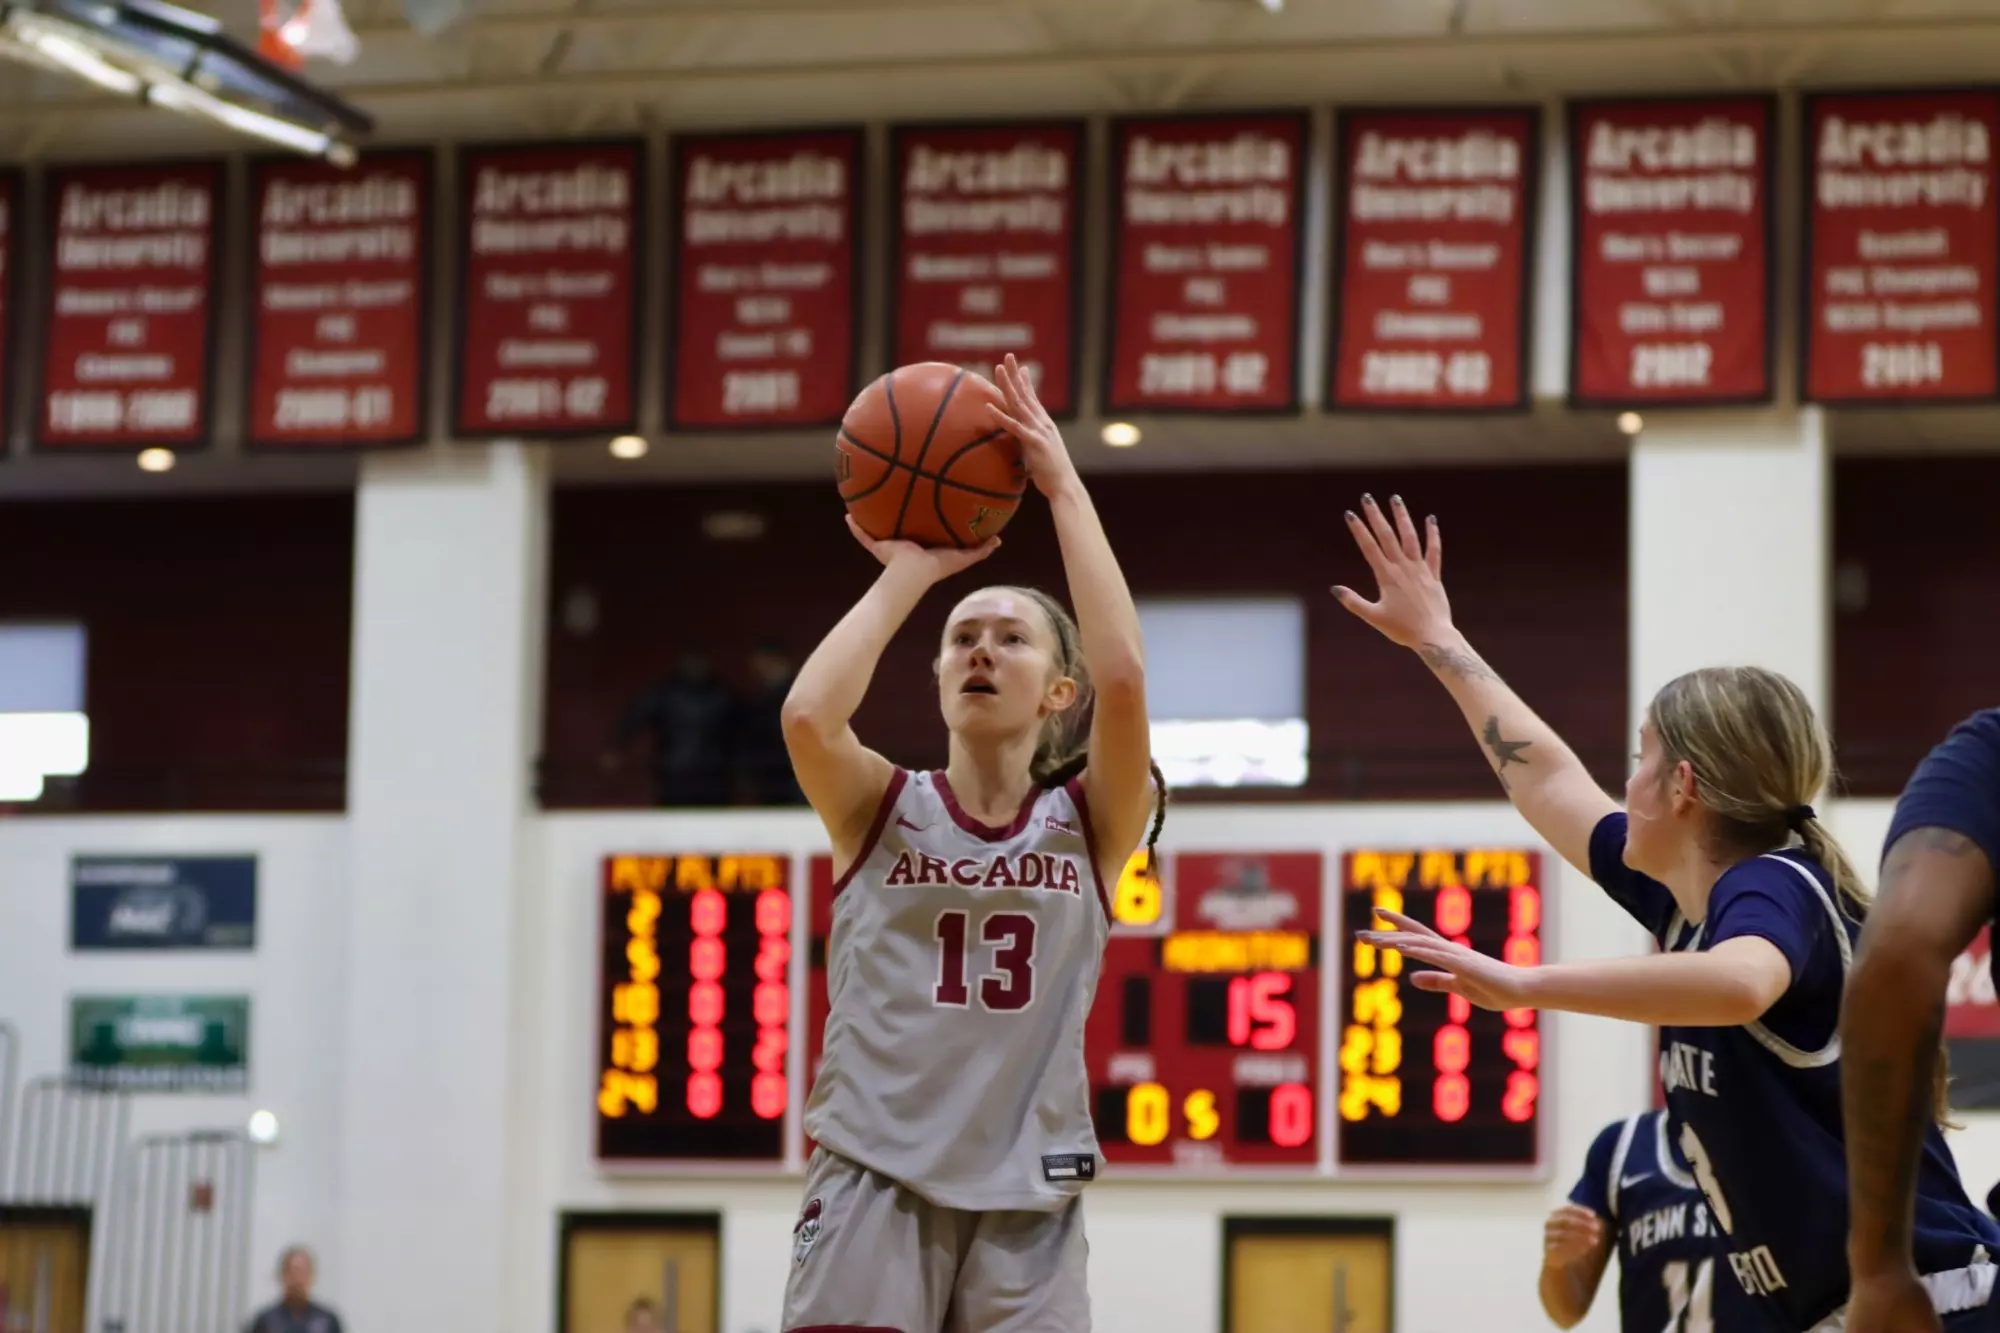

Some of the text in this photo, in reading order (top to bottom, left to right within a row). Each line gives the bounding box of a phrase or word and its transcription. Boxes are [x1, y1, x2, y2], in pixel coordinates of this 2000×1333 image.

[1128, 136, 1288, 182] Arcadia
[1356, 133, 1519, 180] Arcadia
[1587, 121, 1756, 169] Arcadia
[1820, 117, 1989, 164] Arcadia
[884, 849, 1082, 898] ARCADIA
[1436, 885, 1472, 936] 0
[933, 909, 1038, 1013] 13
[1227, 970, 1296, 1050] 15
[1433, 1024, 1471, 1074] 0
[1660, 1040, 1718, 1098] ATE
[1126, 1082, 1170, 1146] 0
[1268, 1082, 1313, 1147] 0
[1433, 1072, 1470, 1122] 0
[1081, 1161, 1091, 1173] M
[1629, 1202, 1719, 1257] PENN S
